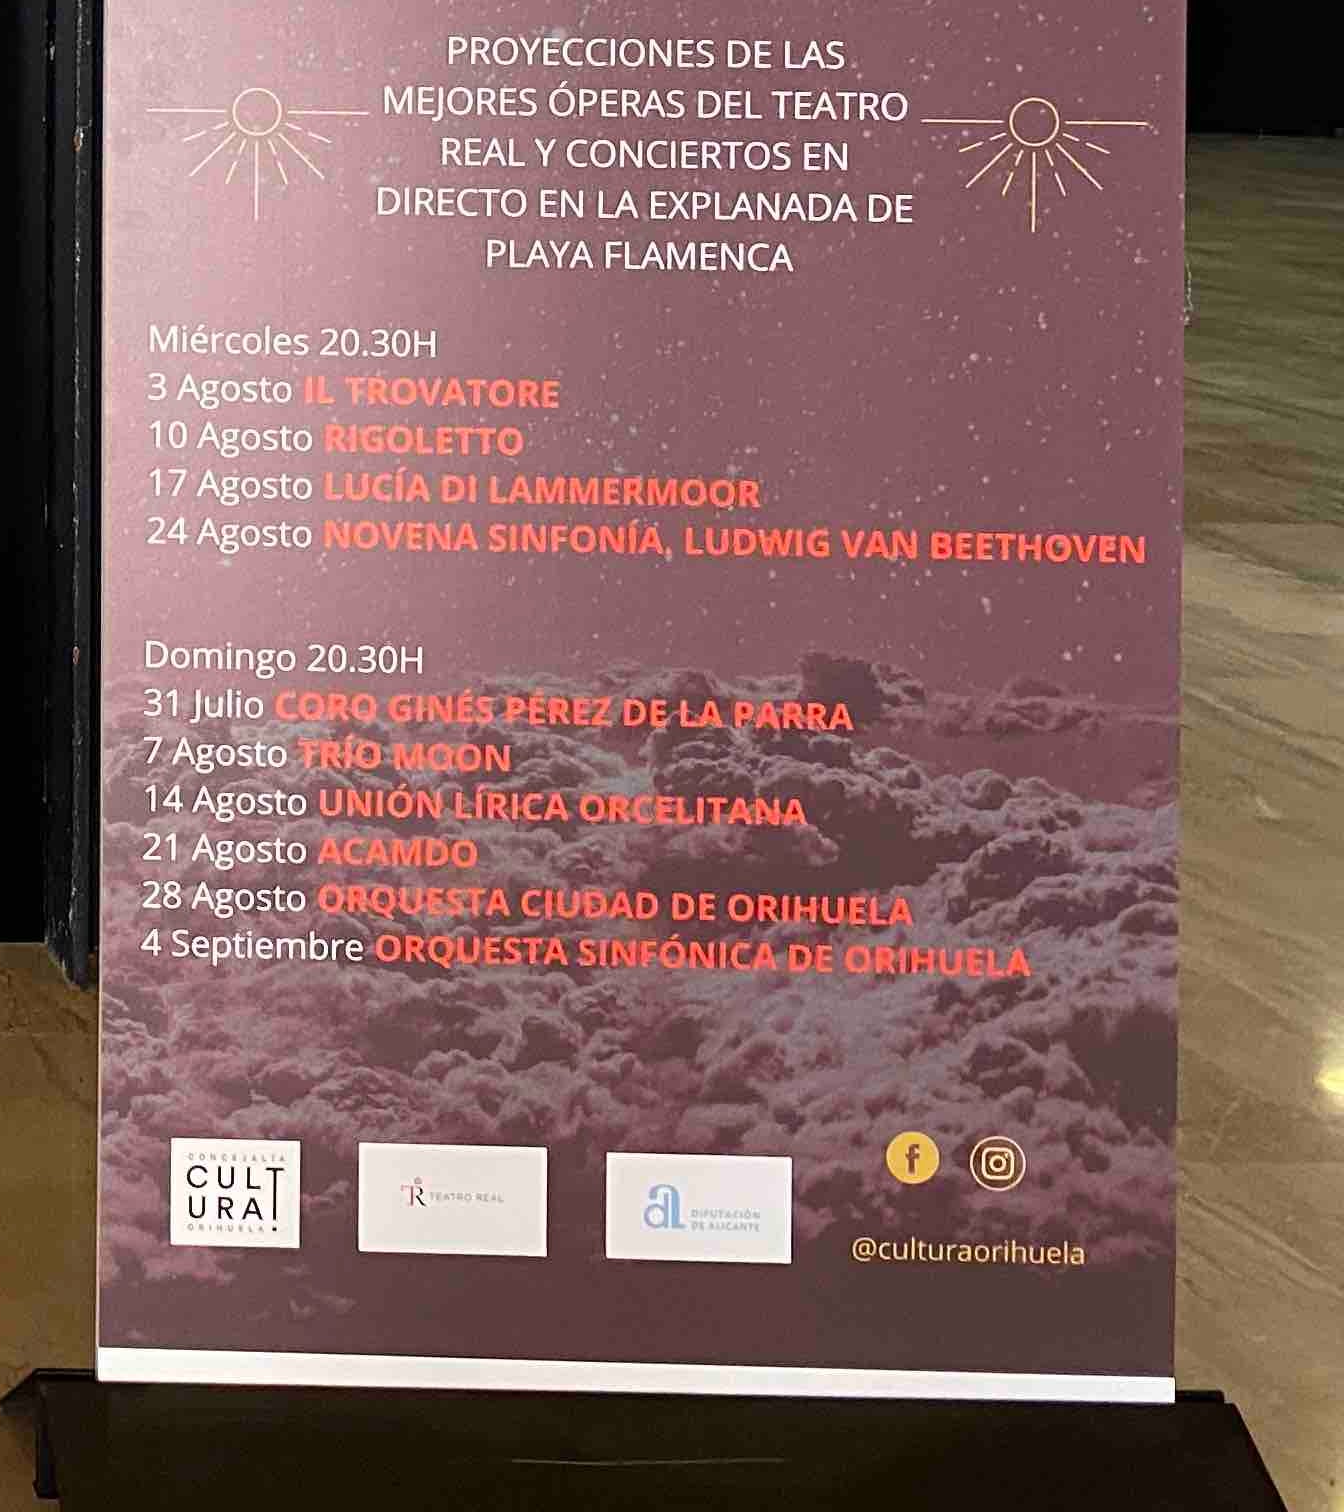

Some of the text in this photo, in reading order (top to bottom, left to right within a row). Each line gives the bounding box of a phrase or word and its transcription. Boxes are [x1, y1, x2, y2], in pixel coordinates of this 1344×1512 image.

[144, 639, 424, 681] Domingo 20.30H
[142, 686, 854, 731] 31 Julio CORO GINÉS PÉREZ DE LA PARRA
[142, 731, 513, 775] 7 Agosto TRÍO MOON
[144, 781, 807, 826] 14 Agosto UNIÓN LÍRICA ORCELITANA
[141, 831, 479, 872] 21 Agosto ACAMDO
[140, 879, 914, 928] 28 Agosto ORQUESTA CIUDAD DE ORIHUELA
[139, 927, 1033, 980] 4 Septiembre ORQUESTA SINFÓNICA DE ORIHUELA
[429, 1192, 504, 1203] TEATRO REAL
[709, 1221, 761, 1233] ALICANTE
[852, 1235, 1085, 1266] @culturaorihuela
